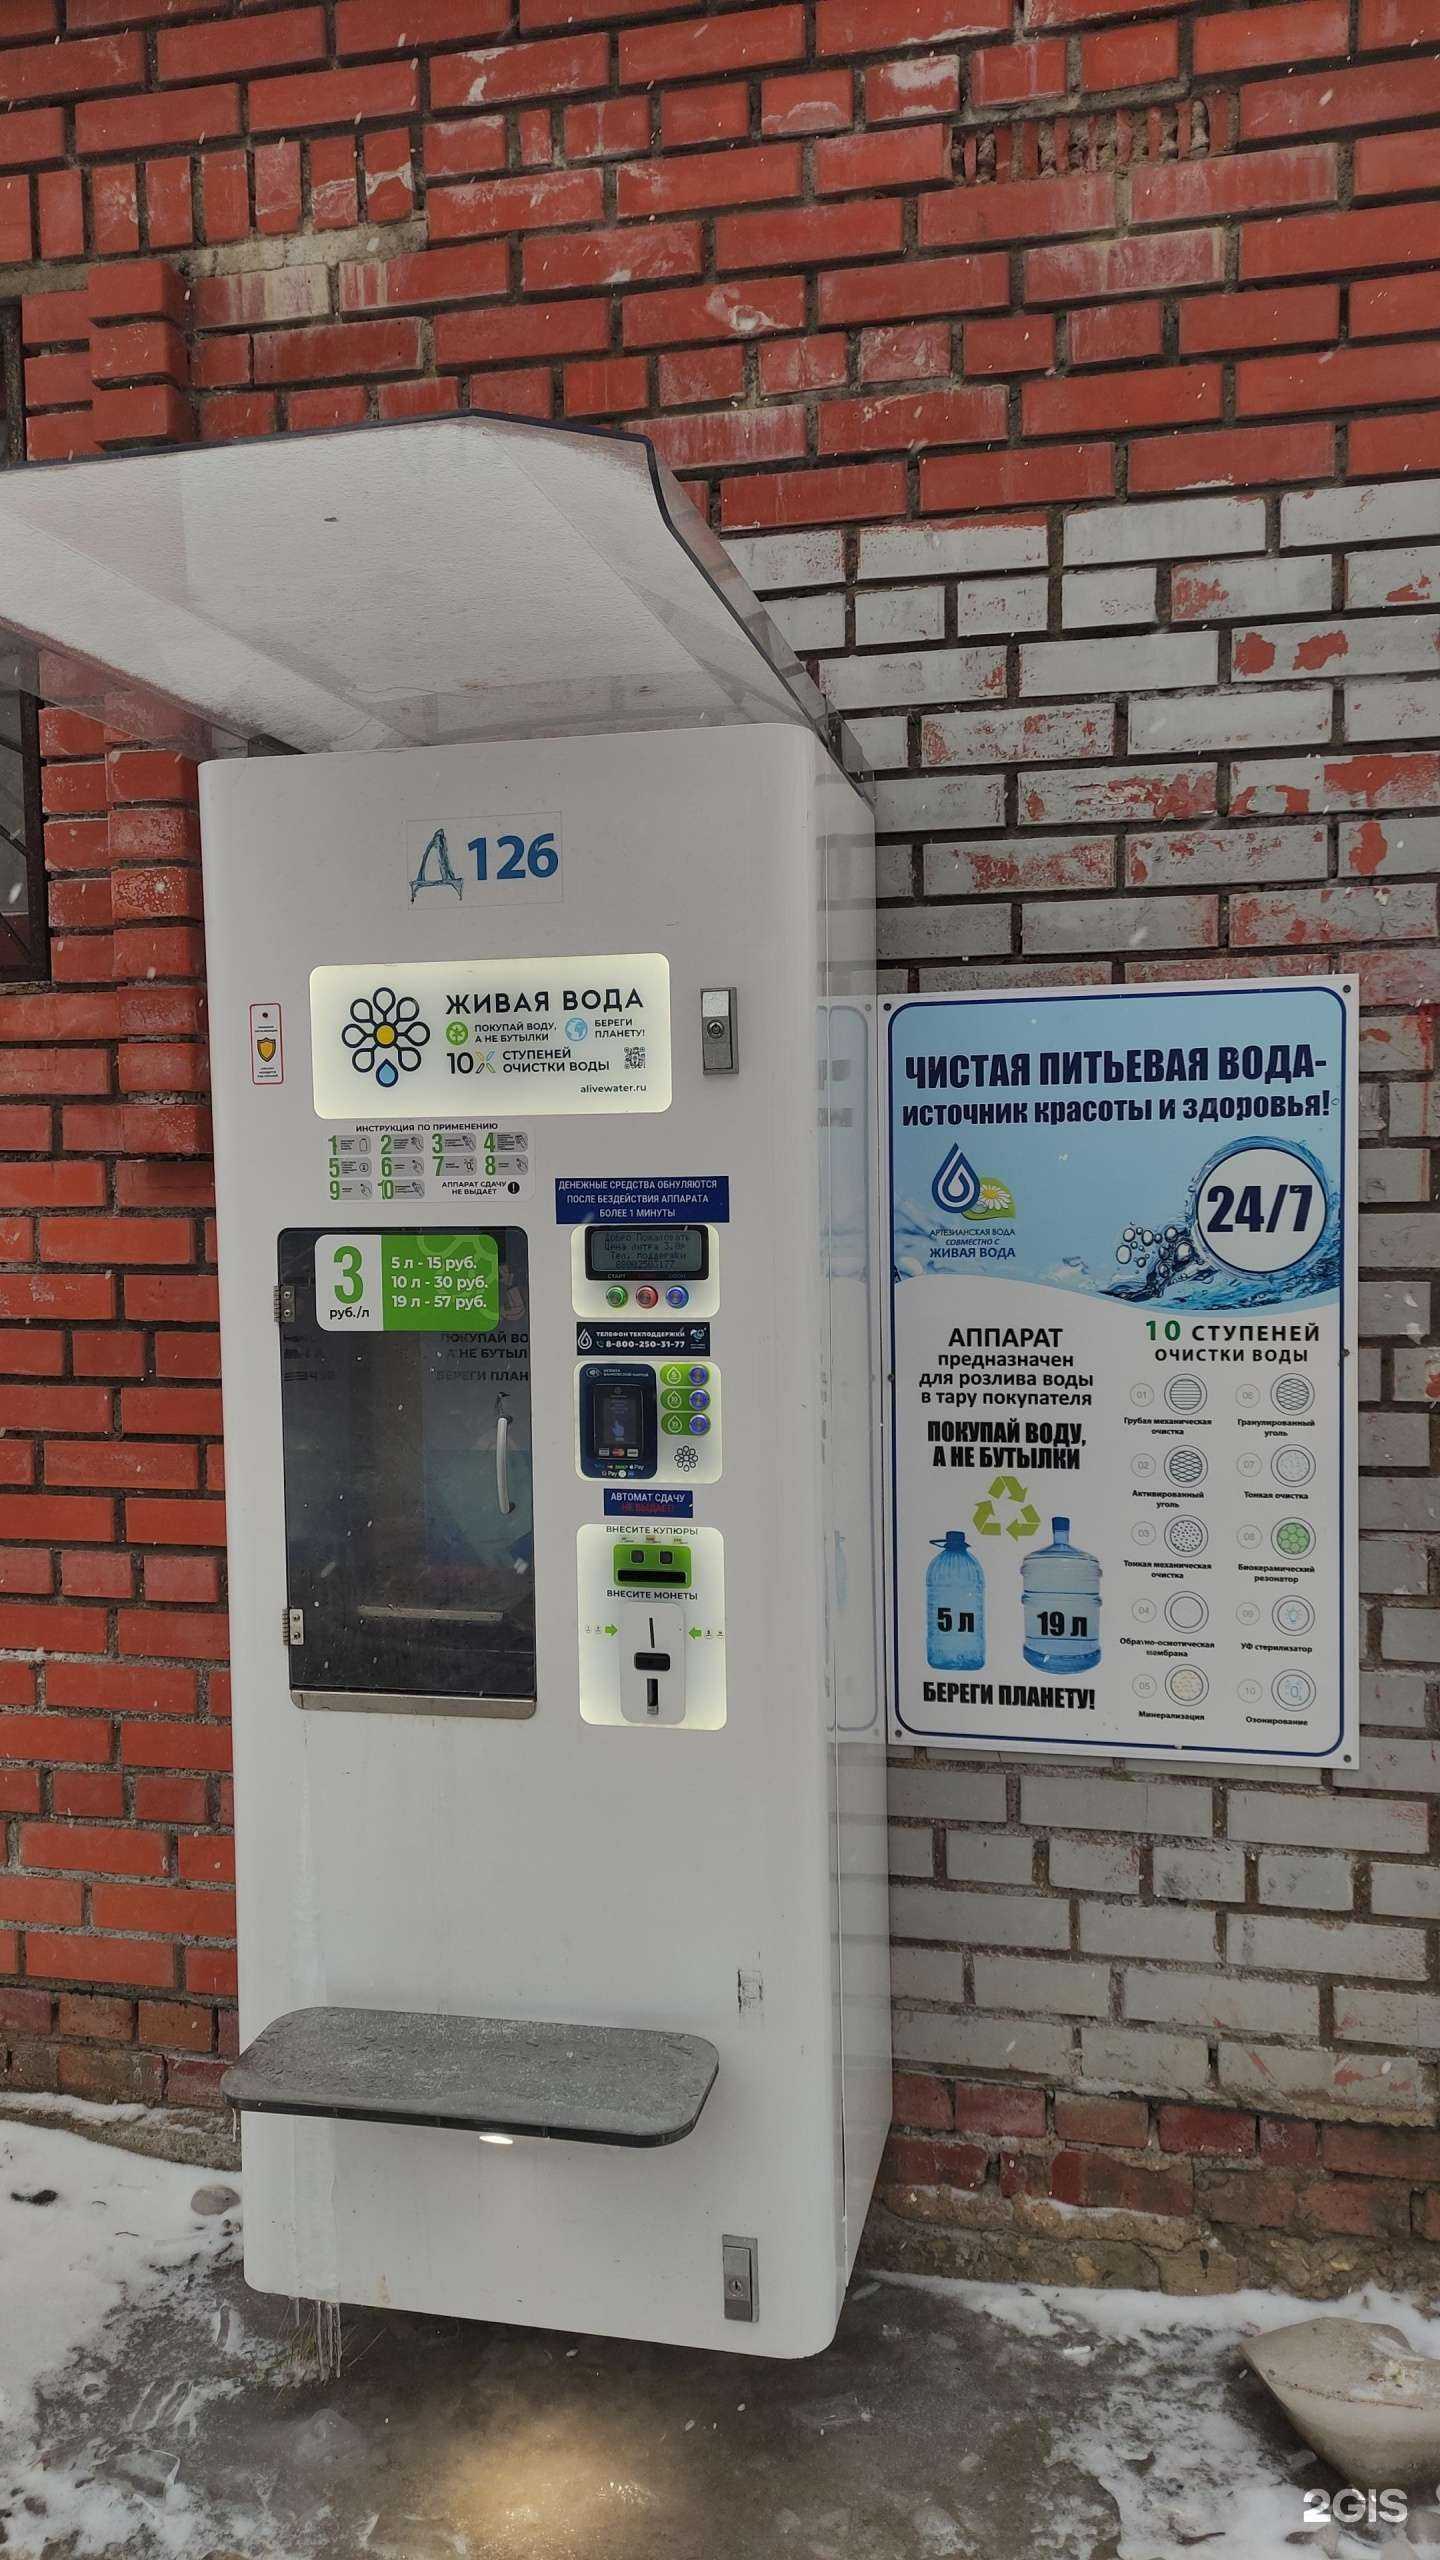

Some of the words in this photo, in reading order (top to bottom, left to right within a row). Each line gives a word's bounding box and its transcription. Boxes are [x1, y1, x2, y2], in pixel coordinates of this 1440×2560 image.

[446, 991, 549, 1014] ЖИВАЯ
[563, 988, 643, 1012] ВОДА
[475, 1022, 524, 1033] ПОКУПАЙ
[527, 1022, 556, 1031] ВОДУ,
[595, 1019, 633, 1027] БЕРЕГИ
[501, 1033, 548, 1042] БУТЫЛКИ
[595, 1029, 645, 1039] ПЛАНЕТУ!
[503, 1047, 571, 1060] СТУПЕНЕЙ
[503, 1062, 565, 1073] ОЧИСТКИ
[570, 1061, 609, 1072] ВОДЫ
[905, 1053, 1029, 1089] ЧИСТАЯ
[1039, 1047, 1208, 1086] ПИТЬЕВАЯ
[1218, 1044, 1327, 1084] ВОДА-
[580, 1084, 646, 1093] alivewater.ru
[903, 1101, 1028, 1126] источник
[1034, 1096, 1152, 1125] красоты
[1159, 1099, 1176, 1120] и
[1183, 1090, 1330, 1122] здоровья!
[328, 1135, 337, 1155] 1
[381, 1135, 392, 1154] 2
[432, 1134, 442, 1153] 3
[484, 1133, 495, 1152] 4
[329, 1158, 339, 1178] 5
[381, 1157, 392, 1177] 6
[432, 1156, 444, 1176] 7
[485, 1156, 496, 1175] 8
[330, 1181, 340, 1200] 9
[378, 1180, 394, 1200] 10
[480, 1181, 506, 1189] СДАЧУ
[559, 1181, 607, 1190] ДЕНЕЖНЫЕ
[610, 1181, 655, 1190] СРЕДСТВА
[658, 1180, 717, 1189] ОБНУЛЯЮТСЯ
[567, 1195, 595, 1203] ПОСЛЕ
[598, 1194, 659, 1204] БЕЗДЕЙСТВИЯ
[600, 1209, 626, 1217] БОЛЕЕ
[630, 1209, 634, 1217] 1
[637, 1209, 675, 1217] МИНУТЫ
[1207, 1185, 1312, 1233] 24/7
[930, 1248, 975, 1258] ЖИВАЯ
[980, 1248, 1015, 1260] ВОДА
[392, 1257, 400, 1268] 5
[404, 1259, 413, 1268] л
[427, 1257, 441, 1268] 15
[446, 1257, 477, 1271] руб.
[333, 1246, 363, 1303] 3
[392, 1276, 407, 1288] 10
[410, 1279, 420, 1288] л
[434, 1276, 452, 1288] 30
[457, 1276, 488, 1290] руб.
[392, 1296, 407, 1307] 19
[410, 1299, 420, 1307] л
[434, 1296, 450, 1307] 57
[456, 1295, 487, 1310] руб.
[330, 1306, 369, 1320] руб./л
[949, 1328, 1063, 1347] АППАРАТ
[1146, 1320, 1181, 1341] 10
[1192, 1323, 1319, 1341] СТУПЕНЕЙ
[938, 1353, 1073, 1369] предназначен
[1155, 1349, 1244, 1362] ОЧИСТКИ
[1253, 1349, 1307, 1364] ВОДЫ
[919, 1373, 952, 1387] для
[959, 1373, 1036, 1388] розлива
[1043, 1374, 1093, 1389] воды
[922, 1392, 930, 1403] в
[936, 1392, 977, 1407] тару
[982, 1392, 1092, 1408] покупателя
[1136, 1391, 1148, 1399] 01
[1238, 1418, 1315, 1428] Гранулированный
[928, 1418, 1020, 1443] ПОКУПАЙ
[1025, 1423, 1086, 1447] ВОДУ,
[1264, 1429, 1288, 1437] уголь
[933, 1446, 946, 1467] А
[951, 1447, 975, 1467] НЕ
[979, 1447, 1080, 1470] БУТЫЛКИ
[611, 1493, 653, 1501] АВТОМАТ
[655, 1494, 685, 1503] СДАЧУ
[1132, 1490, 1204, 1499] Активированный
[1244, 1491, 1274, 1499] Тонкая
[1275, 1492, 1309, 1500] очистка
[1156, 1501, 1180, 1509] уголь
[654, 1527, 698, 1535] КУПЮРЫ
[1238, 1563, 1315, 1573] Биокерамический
[1254, 1575, 1298, 1583] резонатор
[607, 1590, 651, 1599] ВНЕСИТЕ
[654, 1592, 698, 1600] МОНЕТЫ
[938, 1608, 952, 1632] 5
[958, 1612, 974, 1632] л
[1037, 1611, 1064, 1636] 19
[1070, 1616, 1087, 1637] л
[1241, 1642, 1253, 1650] УФ
[1254, 1644, 1313, 1653] стерилизатор
[923, 1681, 993, 1705] БЕРЕГИ
[999, 1684, 1095, 1710] ПЛАНЕТУ!
[1139, 1711, 1205, 1721] Минерализация
[1246, 1716, 1308, 1726] Озонирование
